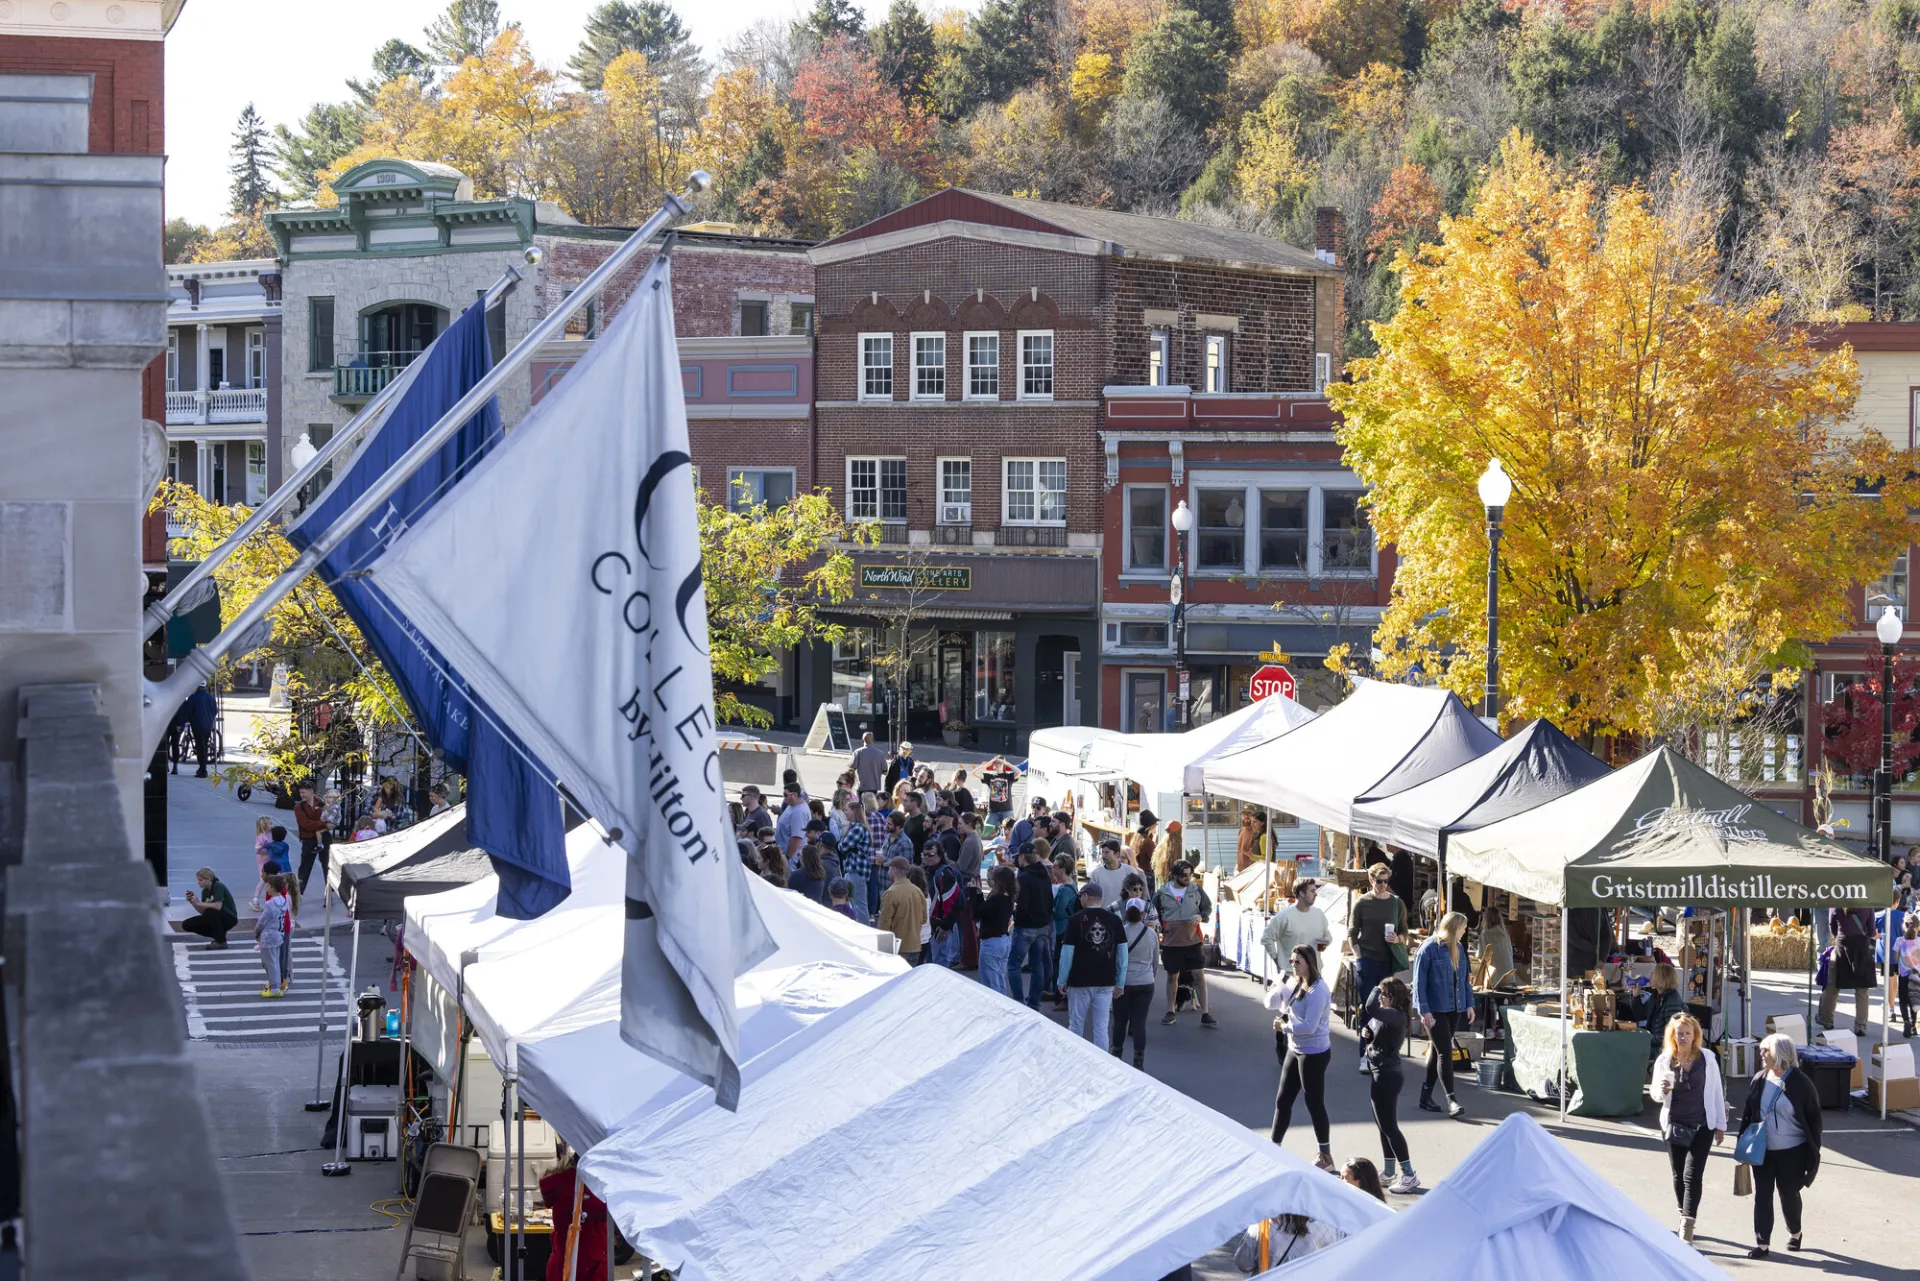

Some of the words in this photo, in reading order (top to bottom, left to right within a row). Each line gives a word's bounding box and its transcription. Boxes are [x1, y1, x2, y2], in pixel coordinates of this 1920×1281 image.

[376, 173, 397, 184] 1900
[1253, 680, 1293, 697] STOP
[1591, 874, 1869, 900] Gristmilldistillers.com
